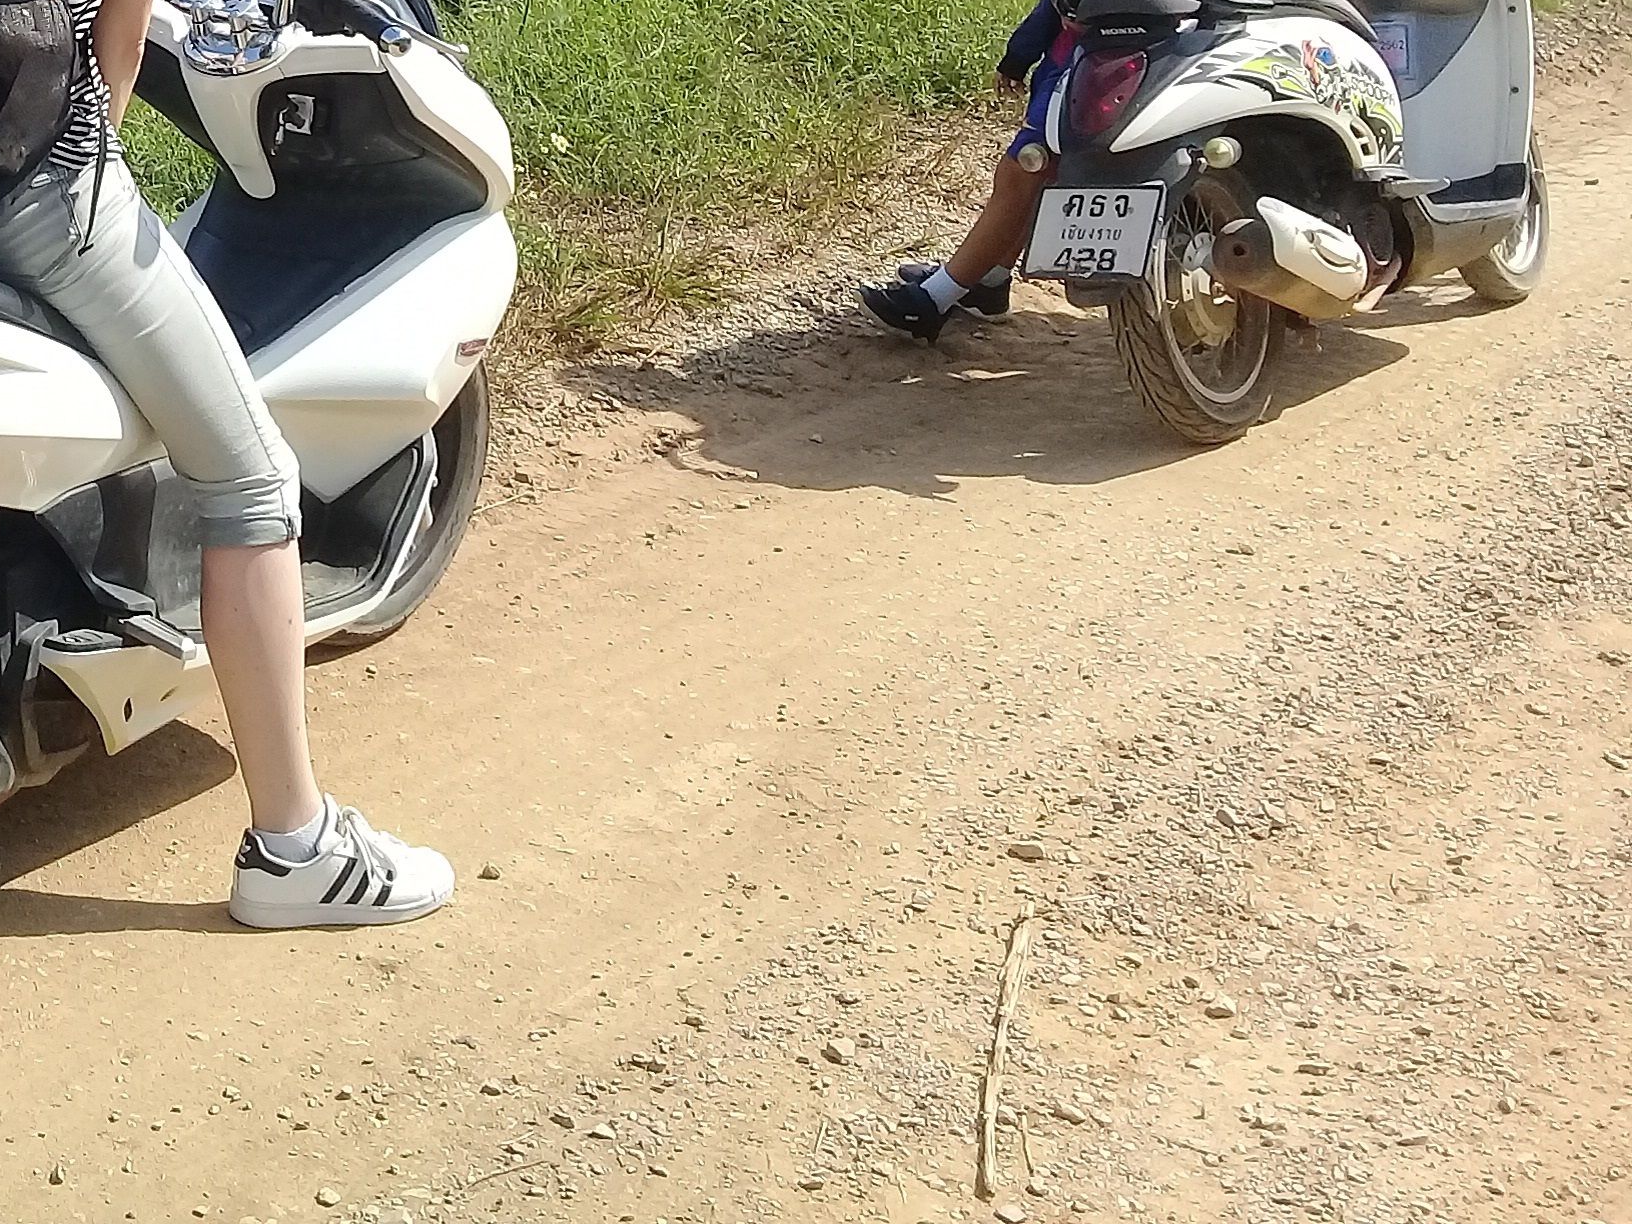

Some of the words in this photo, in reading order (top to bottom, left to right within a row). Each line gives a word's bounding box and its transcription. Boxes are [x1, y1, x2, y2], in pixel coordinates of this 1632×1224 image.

[1100, 26, 1147, 36] HONDA
[1061, 225, 1122, 241] เชียงราย
